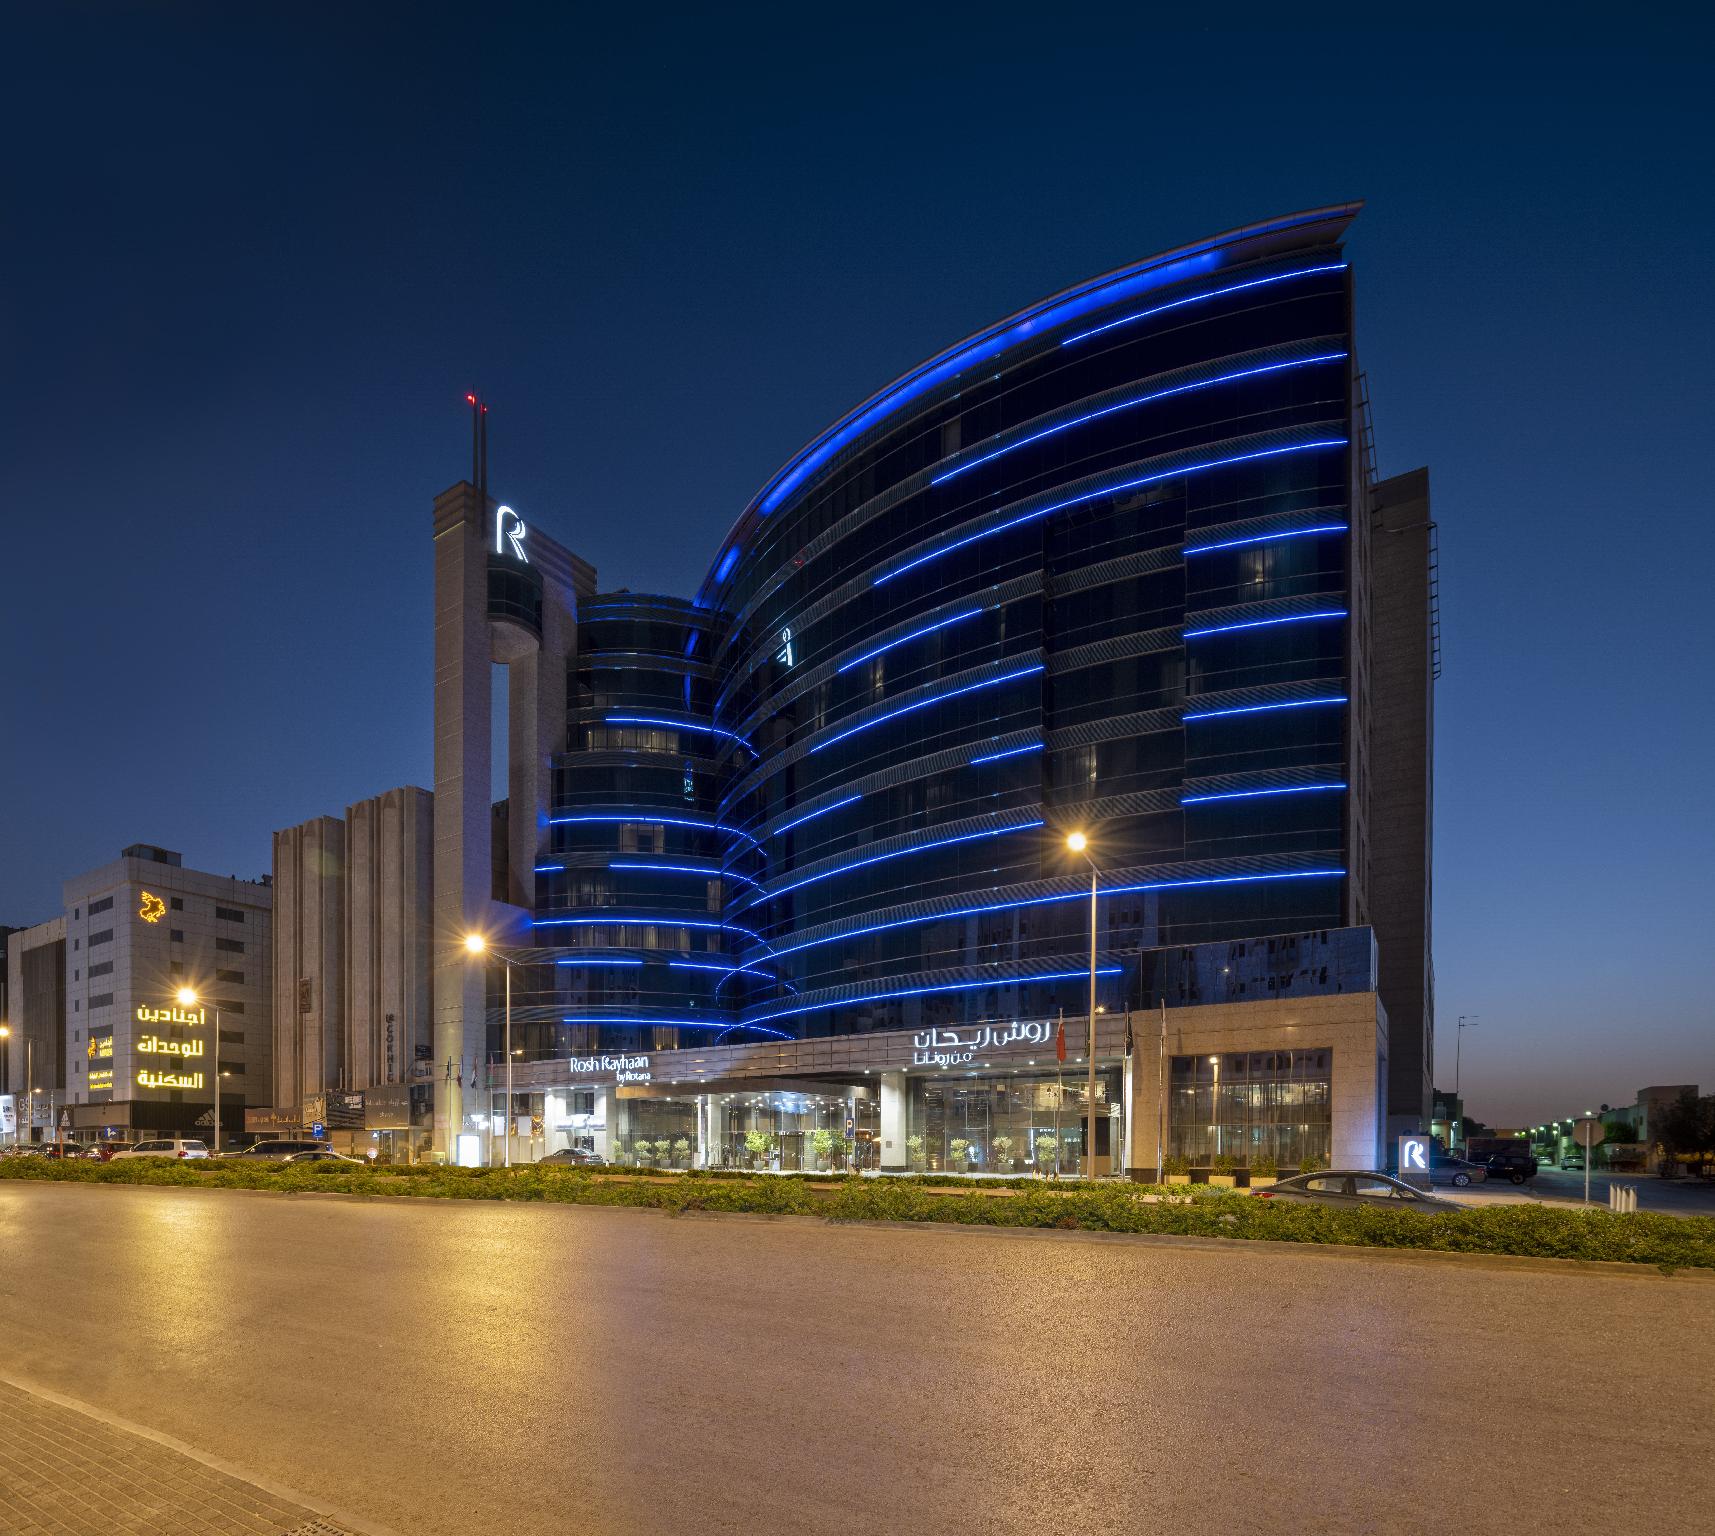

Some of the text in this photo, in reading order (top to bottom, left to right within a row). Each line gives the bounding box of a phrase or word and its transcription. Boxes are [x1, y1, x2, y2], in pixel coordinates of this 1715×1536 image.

[914, 1021, 1050, 1050] روش ريحان
[137, 1036, 203, 1058] للوحدات
[570, 1054, 649, 1073] Rosh Rayhaan
[137, 1070, 203, 1089] السكنية
[616, 1071, 651, 1084] by Rotana
[194, 1119, 224, 1127] adids
[314, 1124, 322, 1134] P
[846, 1119, 853, 1134] P
